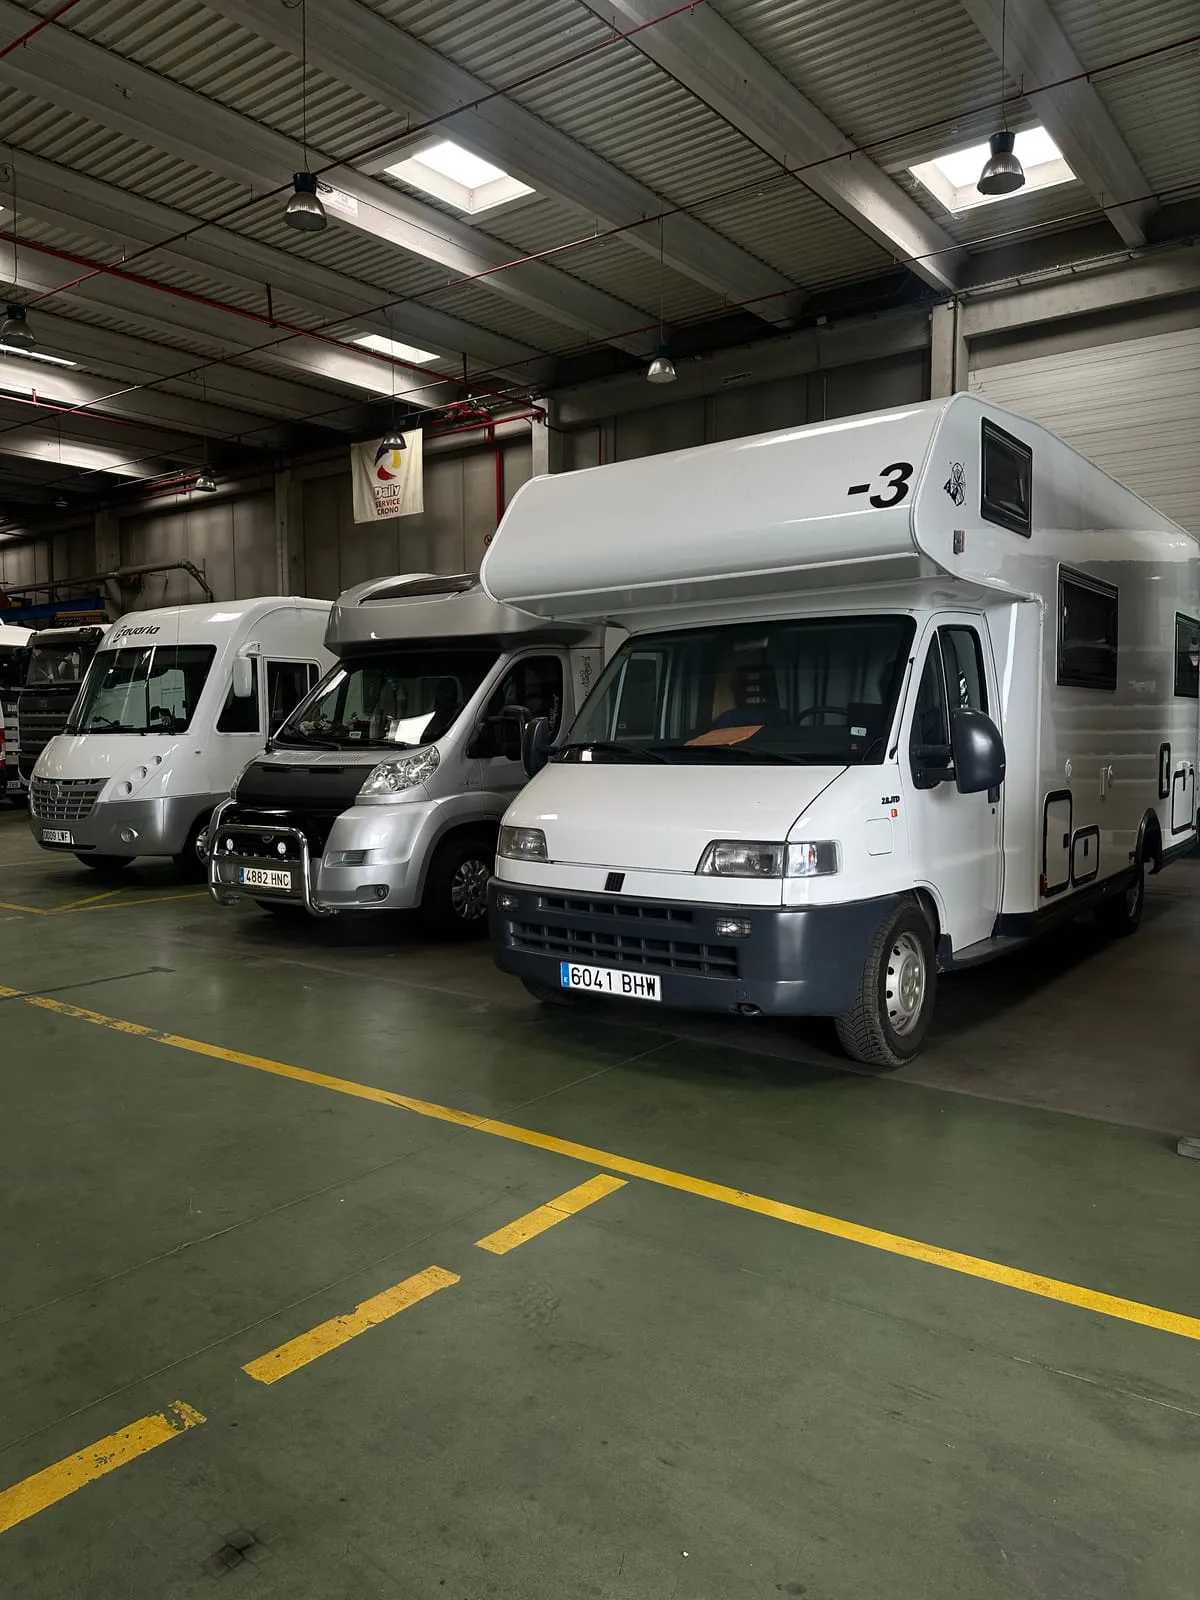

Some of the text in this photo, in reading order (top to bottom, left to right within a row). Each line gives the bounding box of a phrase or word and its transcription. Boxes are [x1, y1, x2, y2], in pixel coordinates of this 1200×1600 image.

[374, 484, 401, 499] Daily
[375, 498, 400, 508] SERVICE
[377, 506, 399, 516] CRONO
[246, 870, 289, 886] 4882 HNC
[571, 967, 656, 997] 6041 BHW
